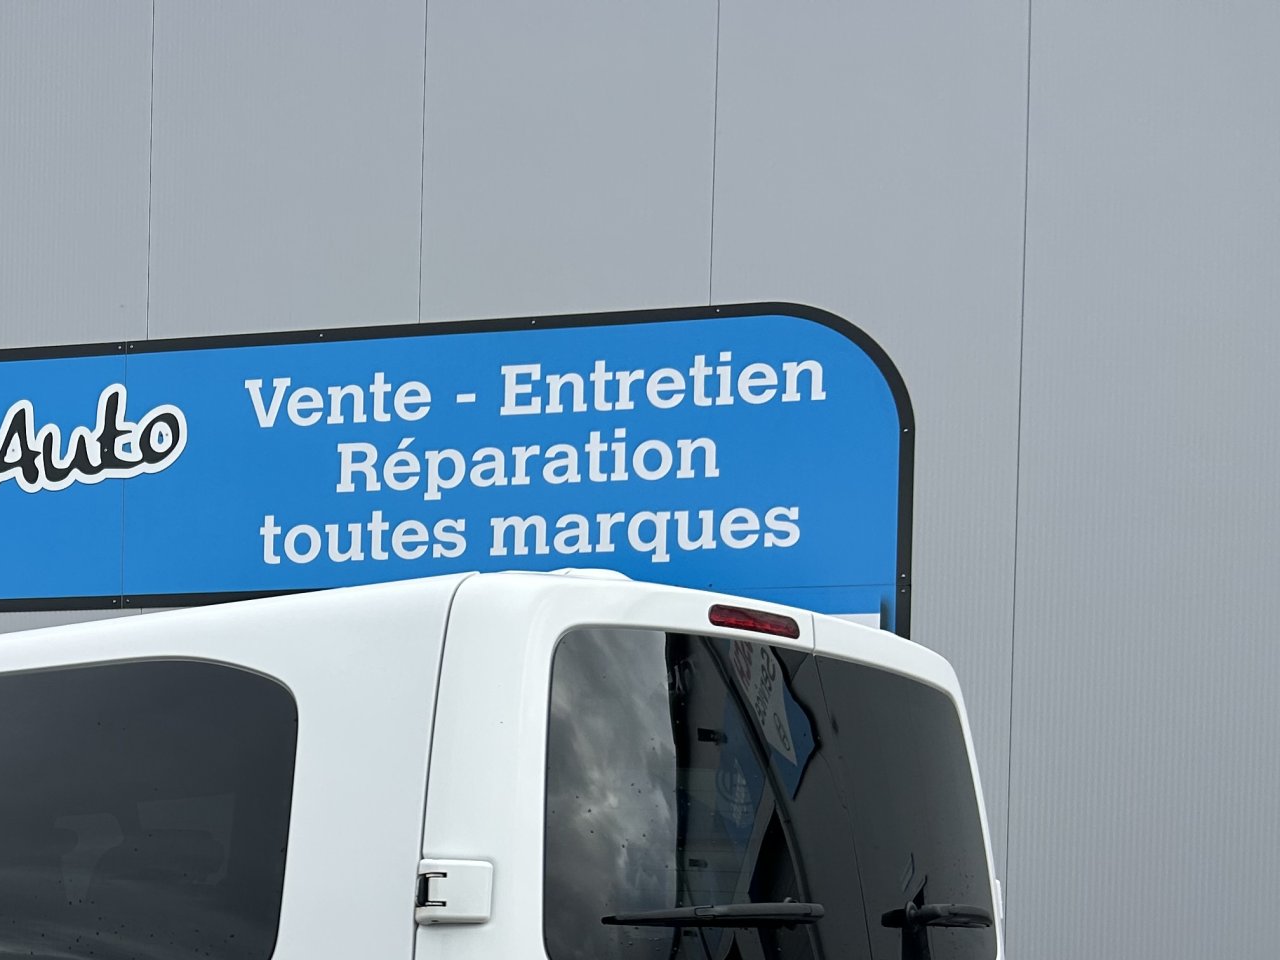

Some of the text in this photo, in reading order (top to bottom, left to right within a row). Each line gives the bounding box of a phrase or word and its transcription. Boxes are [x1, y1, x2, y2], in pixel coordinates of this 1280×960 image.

[244, 372, 432, 428] Vente
[500, 351, 827, 416] Entretien
[336, 427, 720, 501] Réparation
[259, 506, 801, 565] toutes marques
